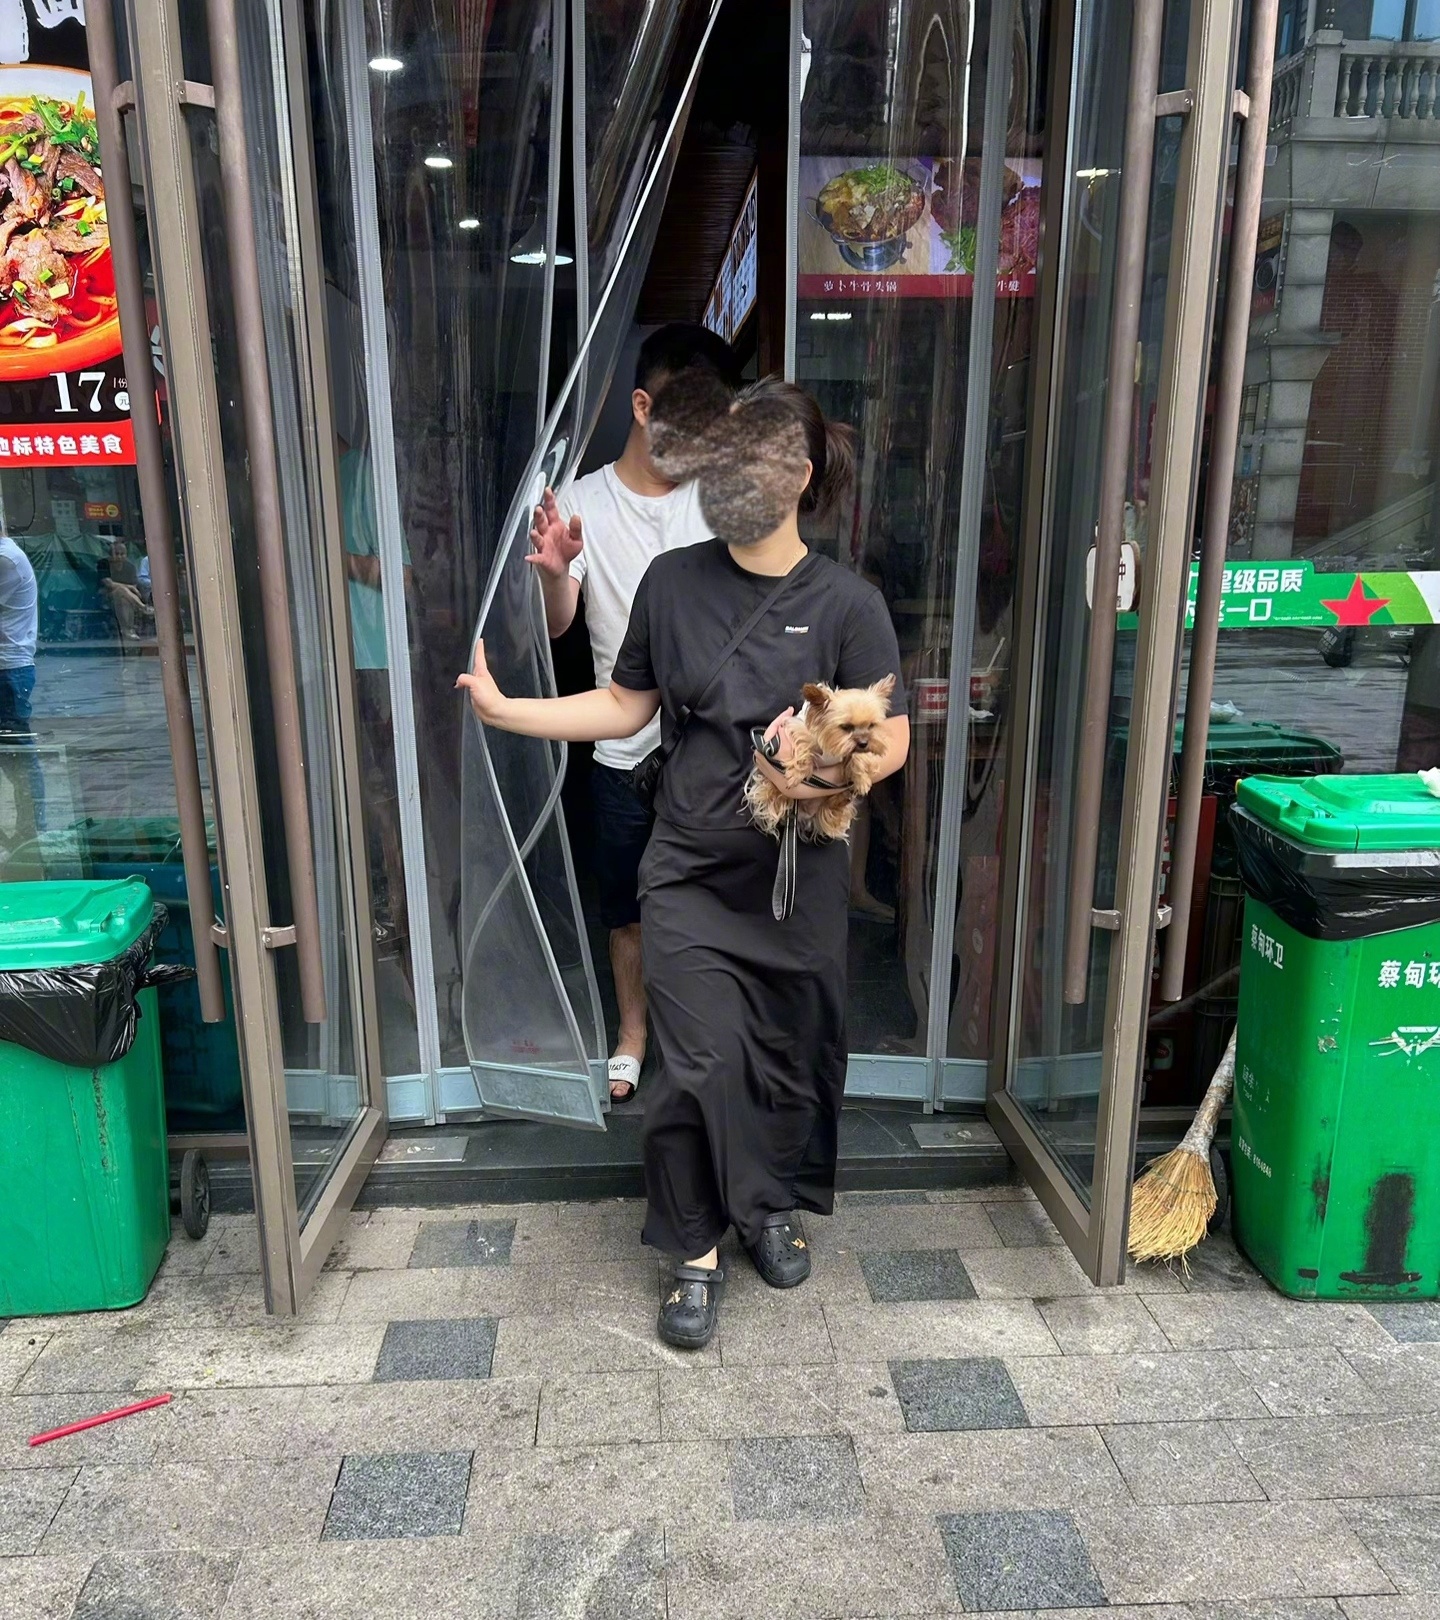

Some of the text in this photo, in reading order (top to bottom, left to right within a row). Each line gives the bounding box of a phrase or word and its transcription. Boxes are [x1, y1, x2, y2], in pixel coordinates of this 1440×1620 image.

[50, 372, 106, 412] 17
[1251, 924, 1284, 970] 蔡甸环卫
